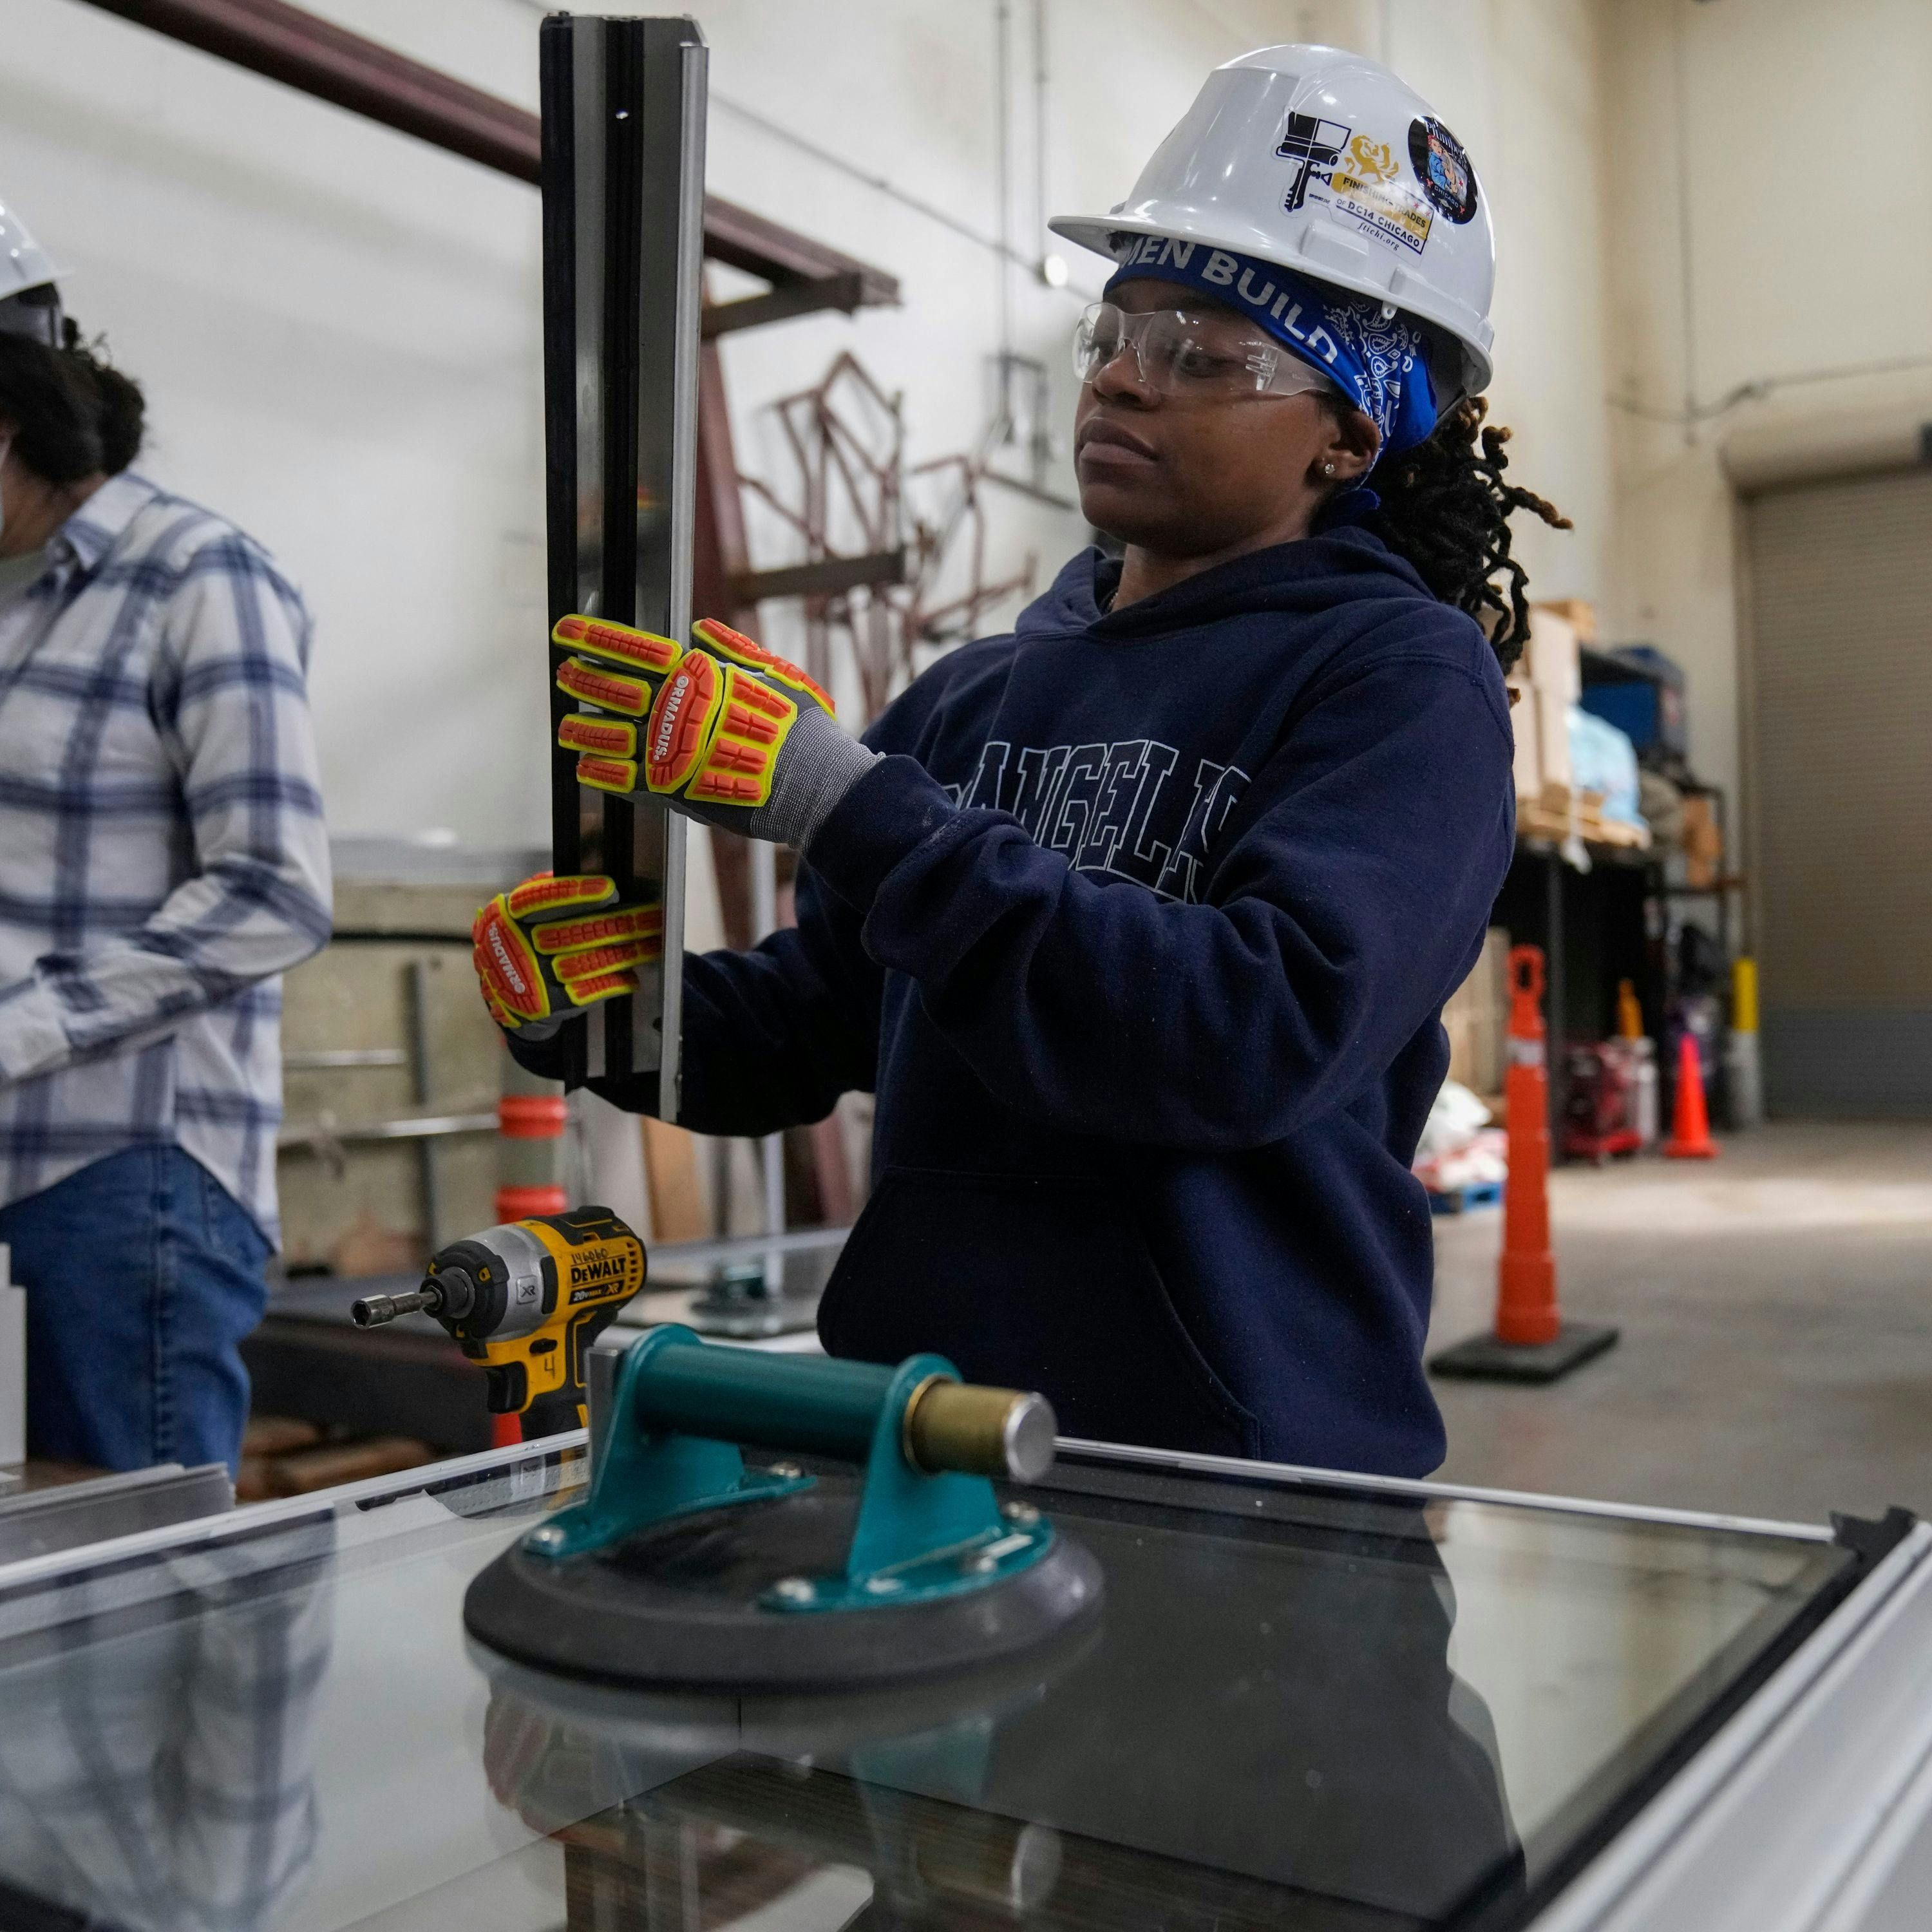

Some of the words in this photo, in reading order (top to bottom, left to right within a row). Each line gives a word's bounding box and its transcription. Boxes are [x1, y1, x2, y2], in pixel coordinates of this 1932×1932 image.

[1347, 201, 1374, 220] DC14
[1378, 216, 1420, 247] CHICAGO
[1394, 204, 1426, 229] TRADES
[1200, 249, 1338, 364] BUILD
[520, 1285, 536, 1298] XR
[544, 1352, 555, 1379] 4
